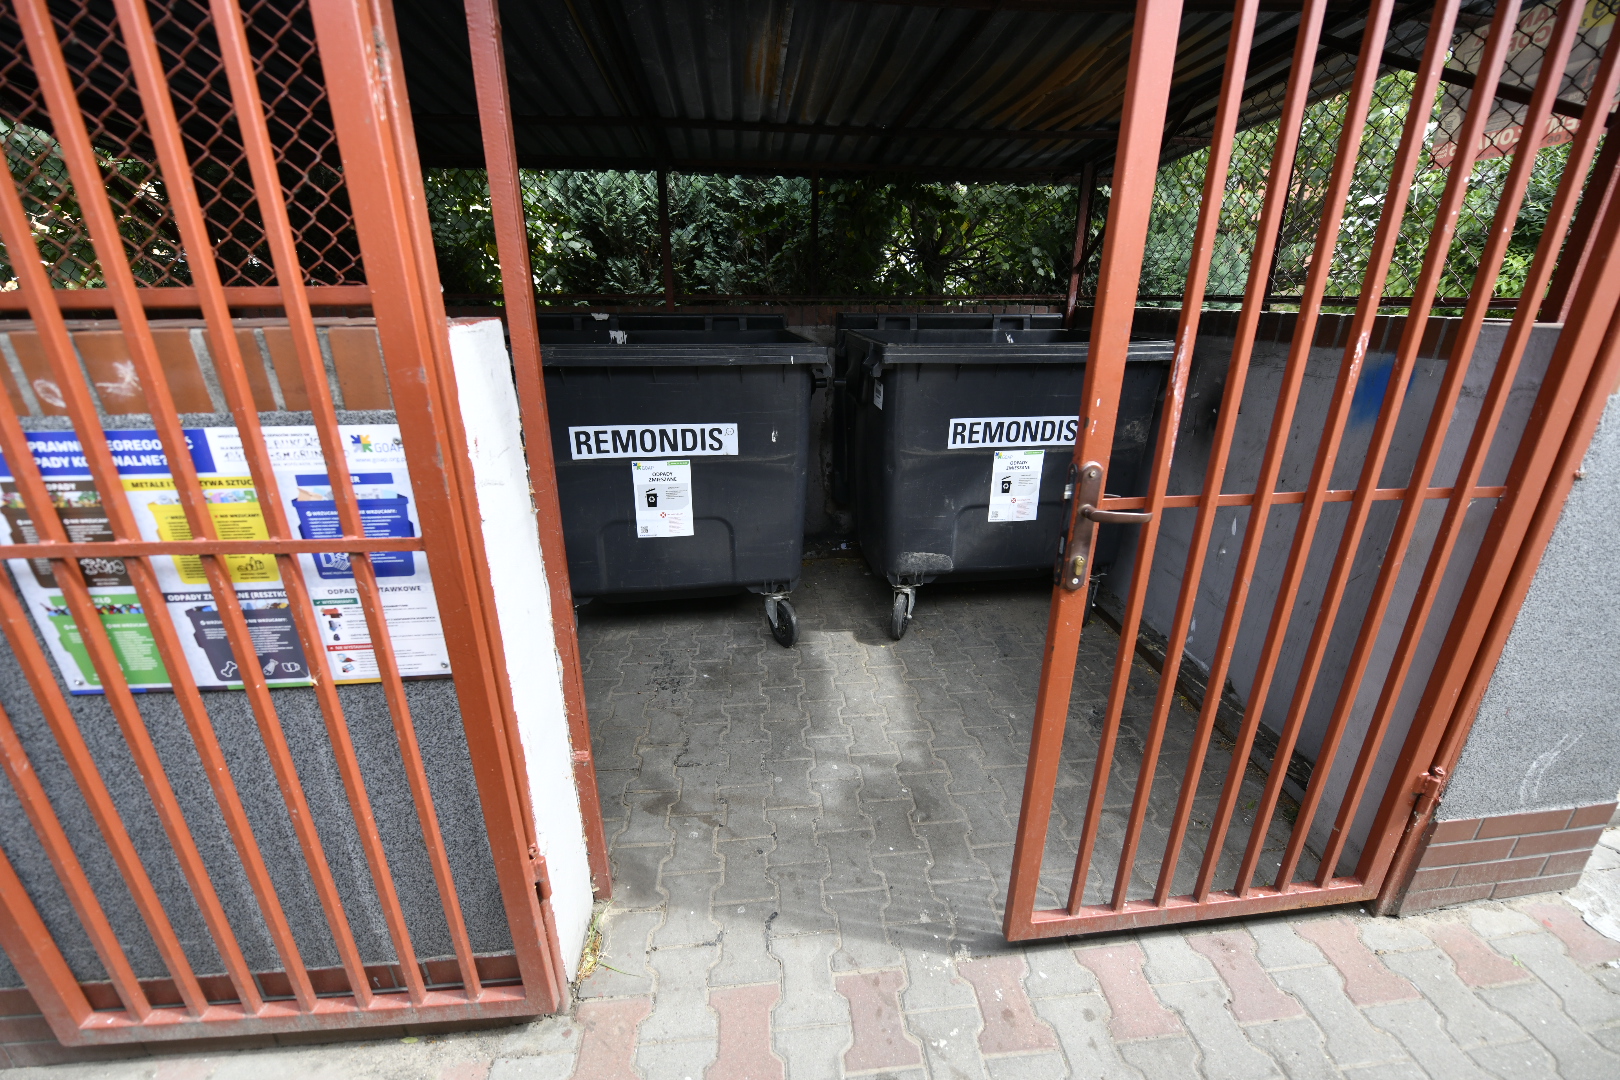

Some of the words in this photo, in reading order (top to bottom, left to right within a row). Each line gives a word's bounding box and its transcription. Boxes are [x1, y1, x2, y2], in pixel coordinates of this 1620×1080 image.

[574, 427, 724, 455] REMONDIS
[952, 419, 1079, 445] REMONDIS
[168, 594, 201, 602] ODPADY
